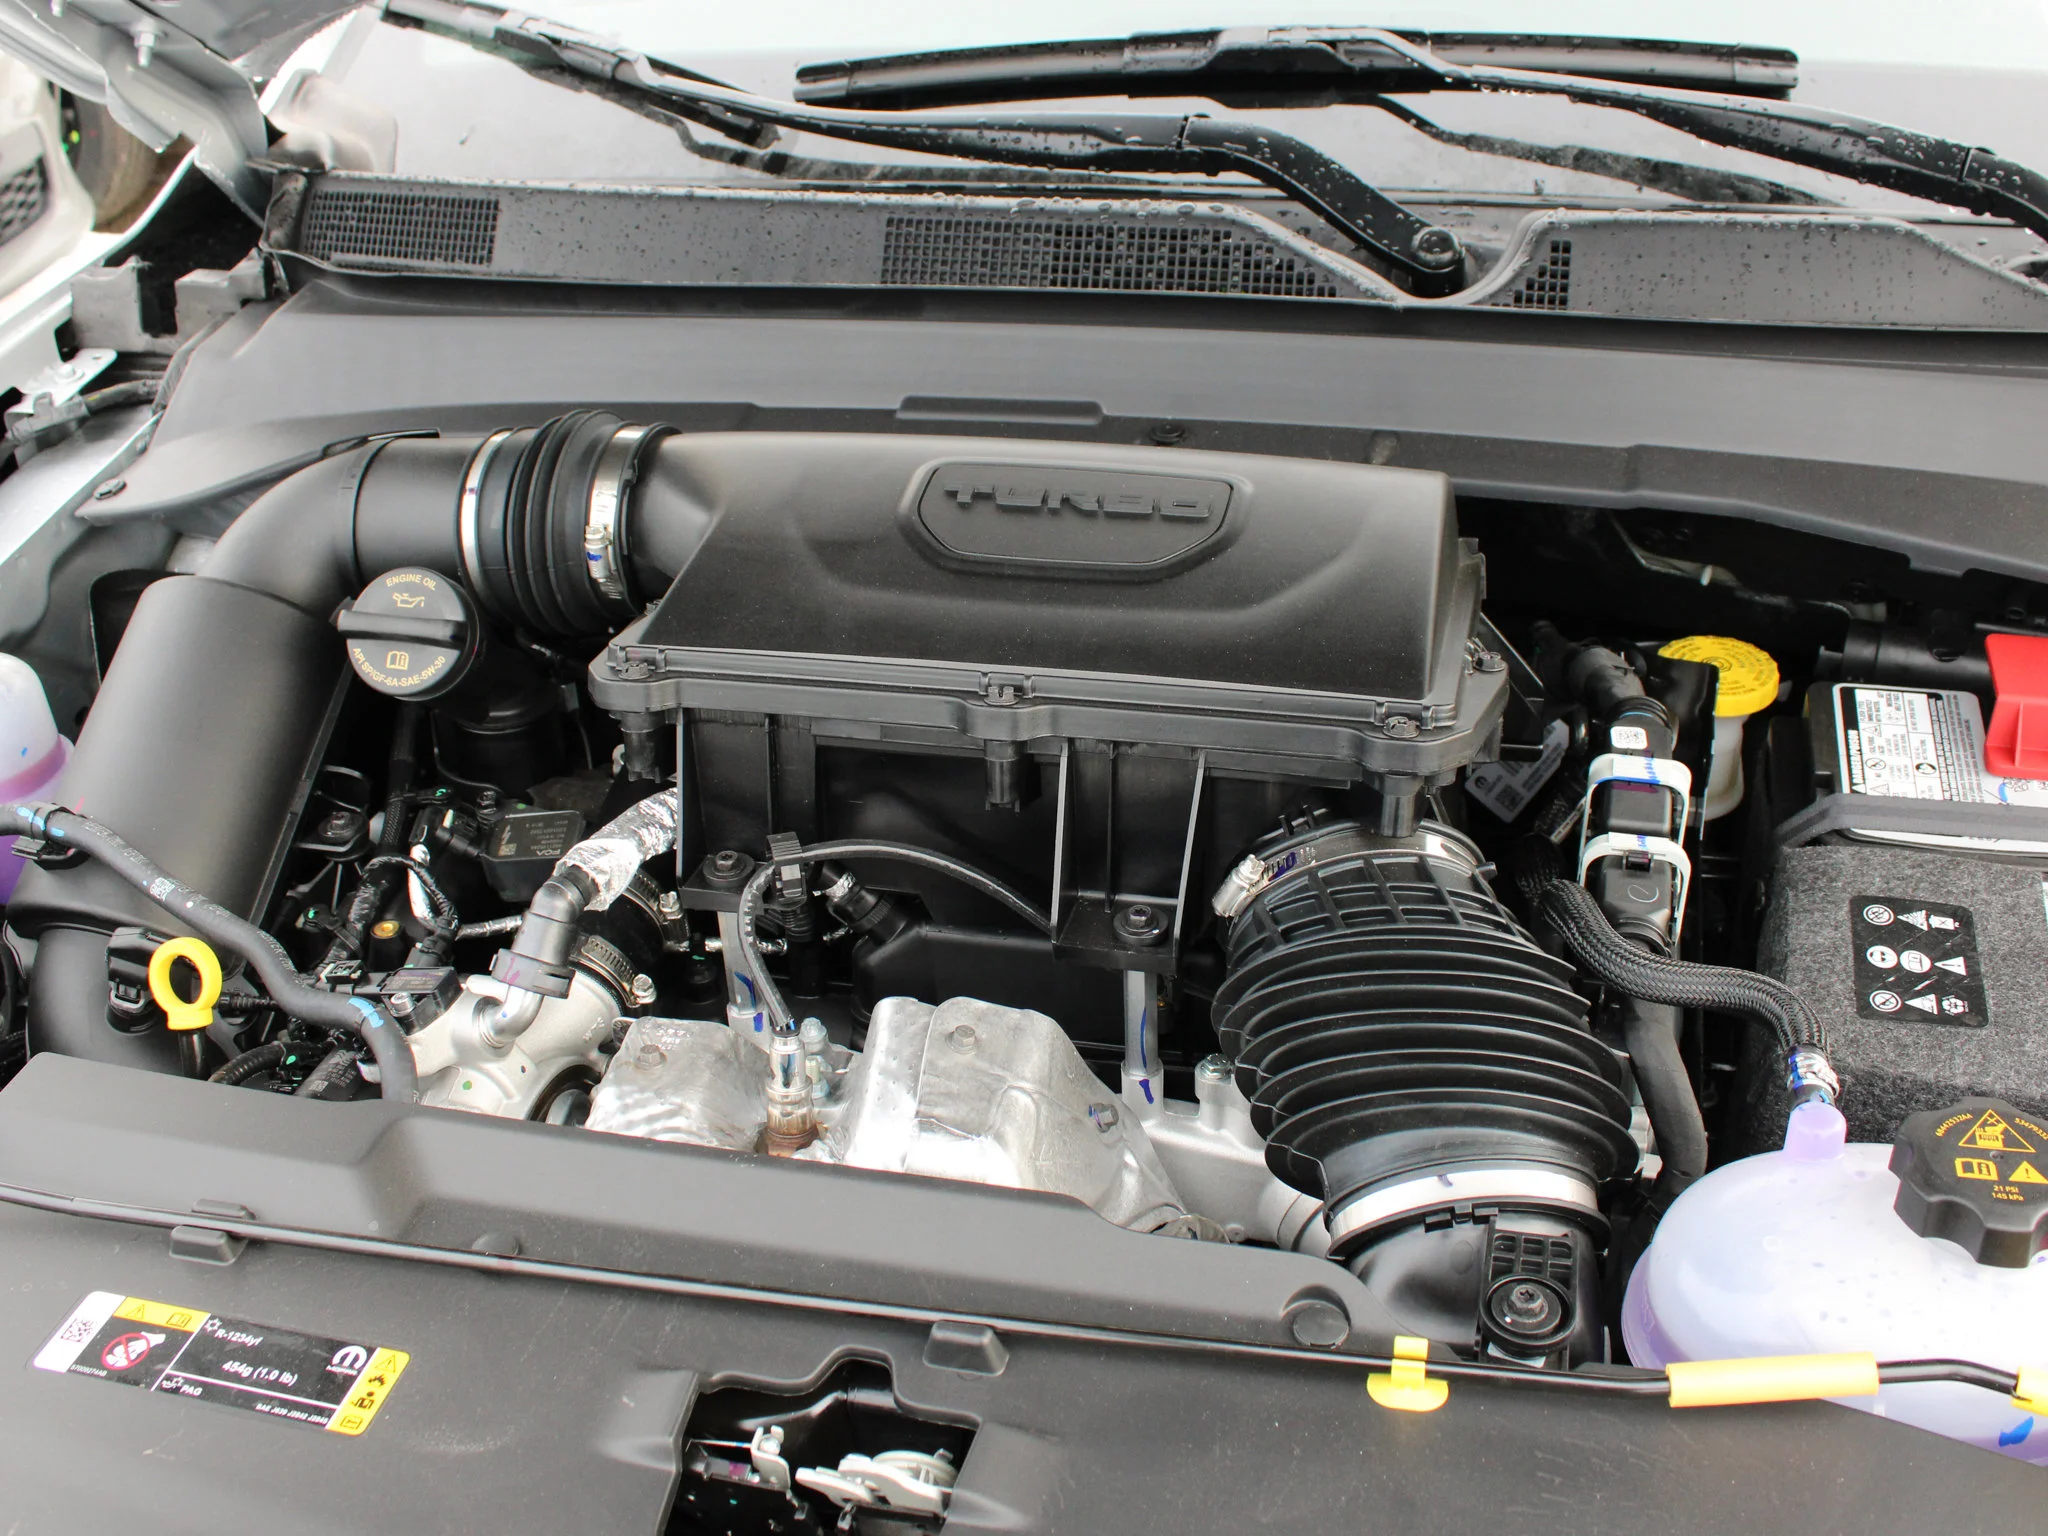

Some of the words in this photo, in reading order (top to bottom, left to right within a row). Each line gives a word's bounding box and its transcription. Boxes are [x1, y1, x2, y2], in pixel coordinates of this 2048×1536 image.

[943, 483, 1212, 519] TURBO
[386, 574, 421, 587] ENGINE
[423, 577, 437, 591] OIL
[353, 648, 364, 664] API
[1991, 1192, 2008, 1200] 145
[2008, 1193, 2025, 1201] kPa
[1993, 1184, 2005, 1192] 21
[2006, 1185, 2020, 1193] PSI
[221, 1360, 253, 1378] 454g
[252, 1366, 280, 1382] (1.0
[278, 1371, 299, 1388] lb)
[179, 1382, 203, 1397] PAG
